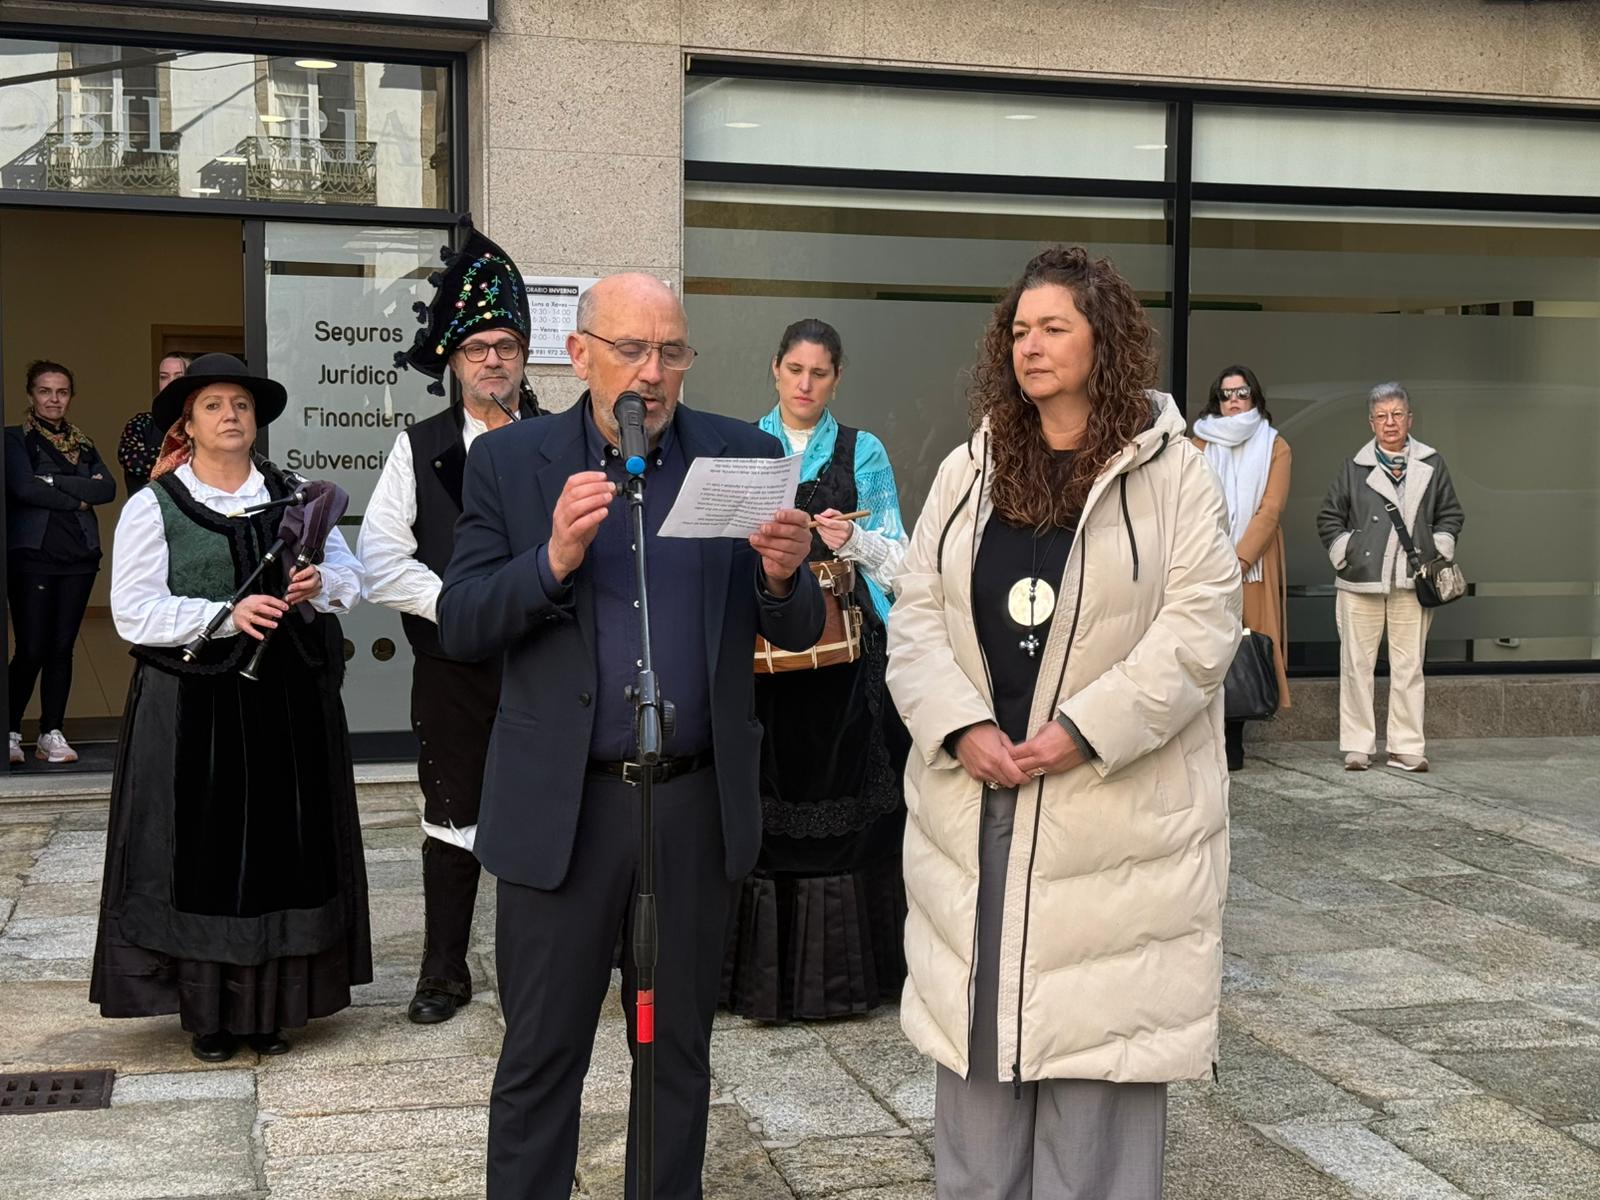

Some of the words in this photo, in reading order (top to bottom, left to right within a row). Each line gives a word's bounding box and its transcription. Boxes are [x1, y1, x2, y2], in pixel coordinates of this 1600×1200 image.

[314, 320, 404, 346] Seguros
[318, 364, 398, 385] Jurídico
[304, 406, 416, 428] Financiero
[286, 448, 388, 470] Subvenci
